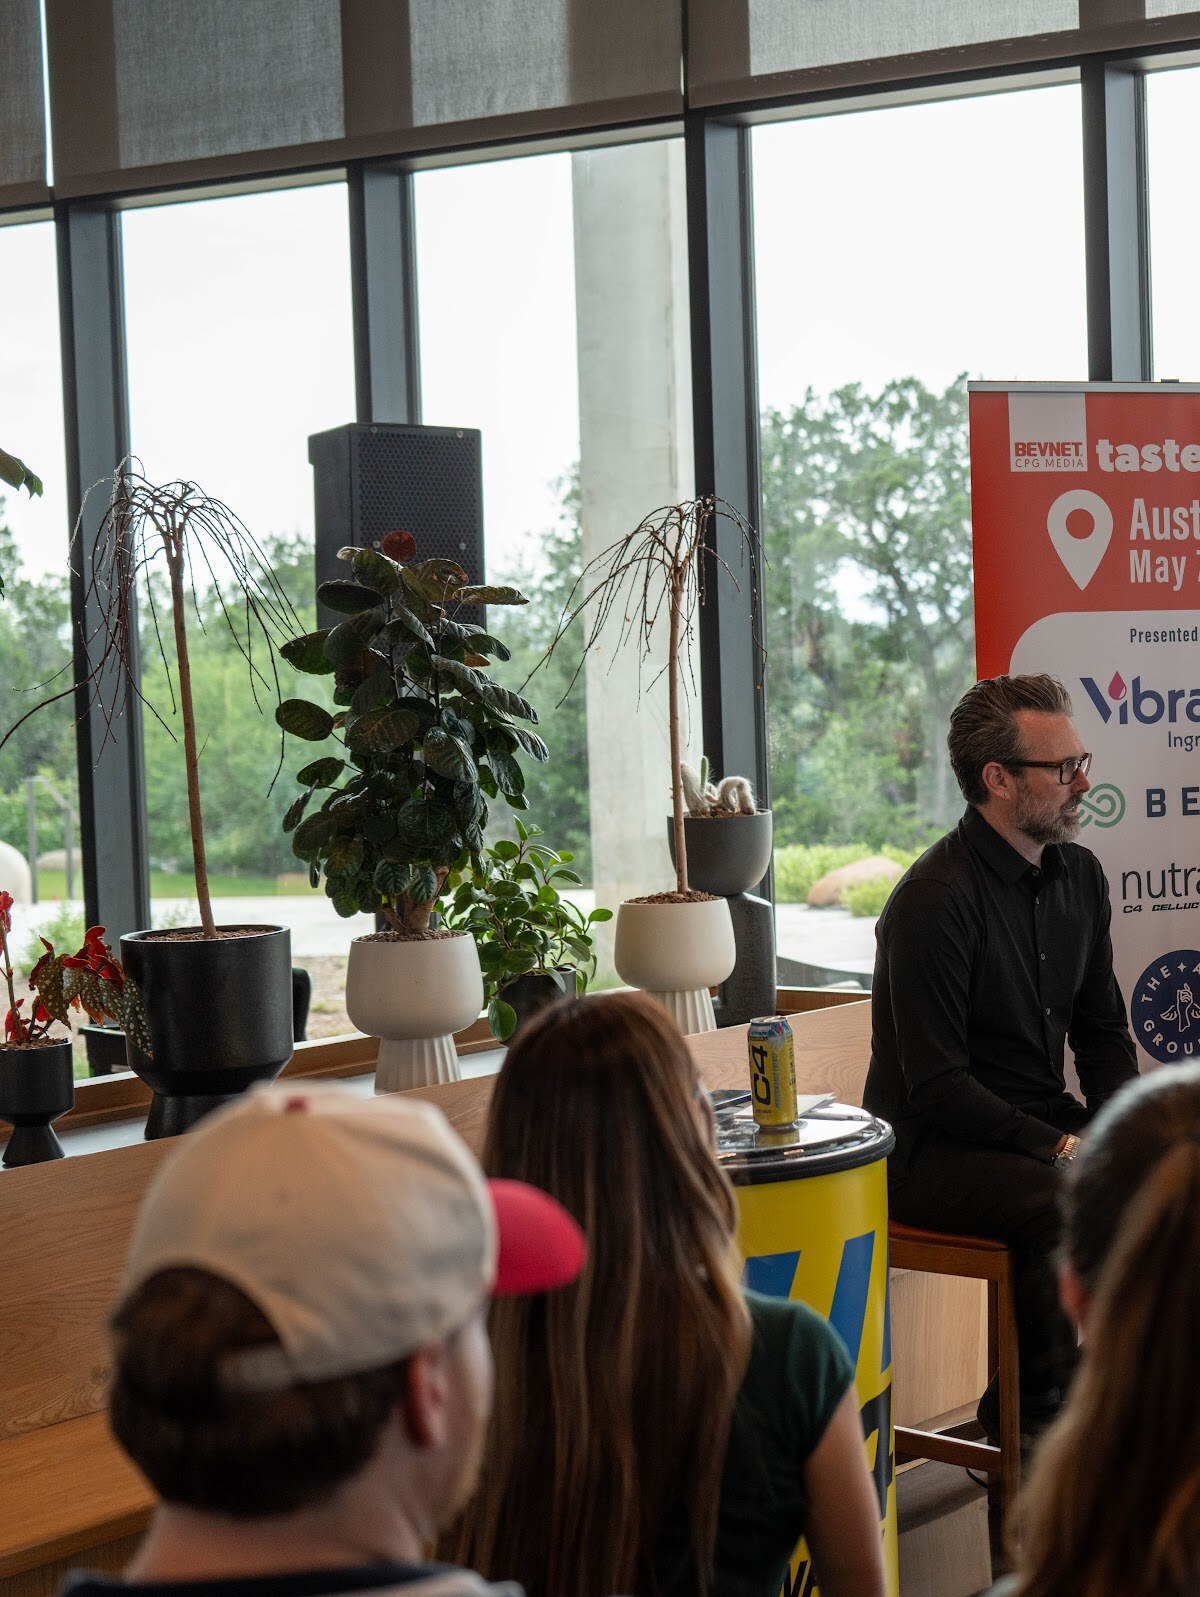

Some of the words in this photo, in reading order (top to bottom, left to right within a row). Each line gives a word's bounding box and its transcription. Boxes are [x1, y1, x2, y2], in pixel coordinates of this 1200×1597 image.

[1015, 442, 1083, 457] BEVNET
[1015, 458, 1040, 468] CPG
[1045, 458, 1084, 468] MEDIA
[1129, 549, 1187, 592] May
[1130, 626, 1198, 643] Presented
[1122, 904, 1143, 914] C4
[1141, 965, 1172, 1003] THE
[751, 1045, 771, 1106] C4
